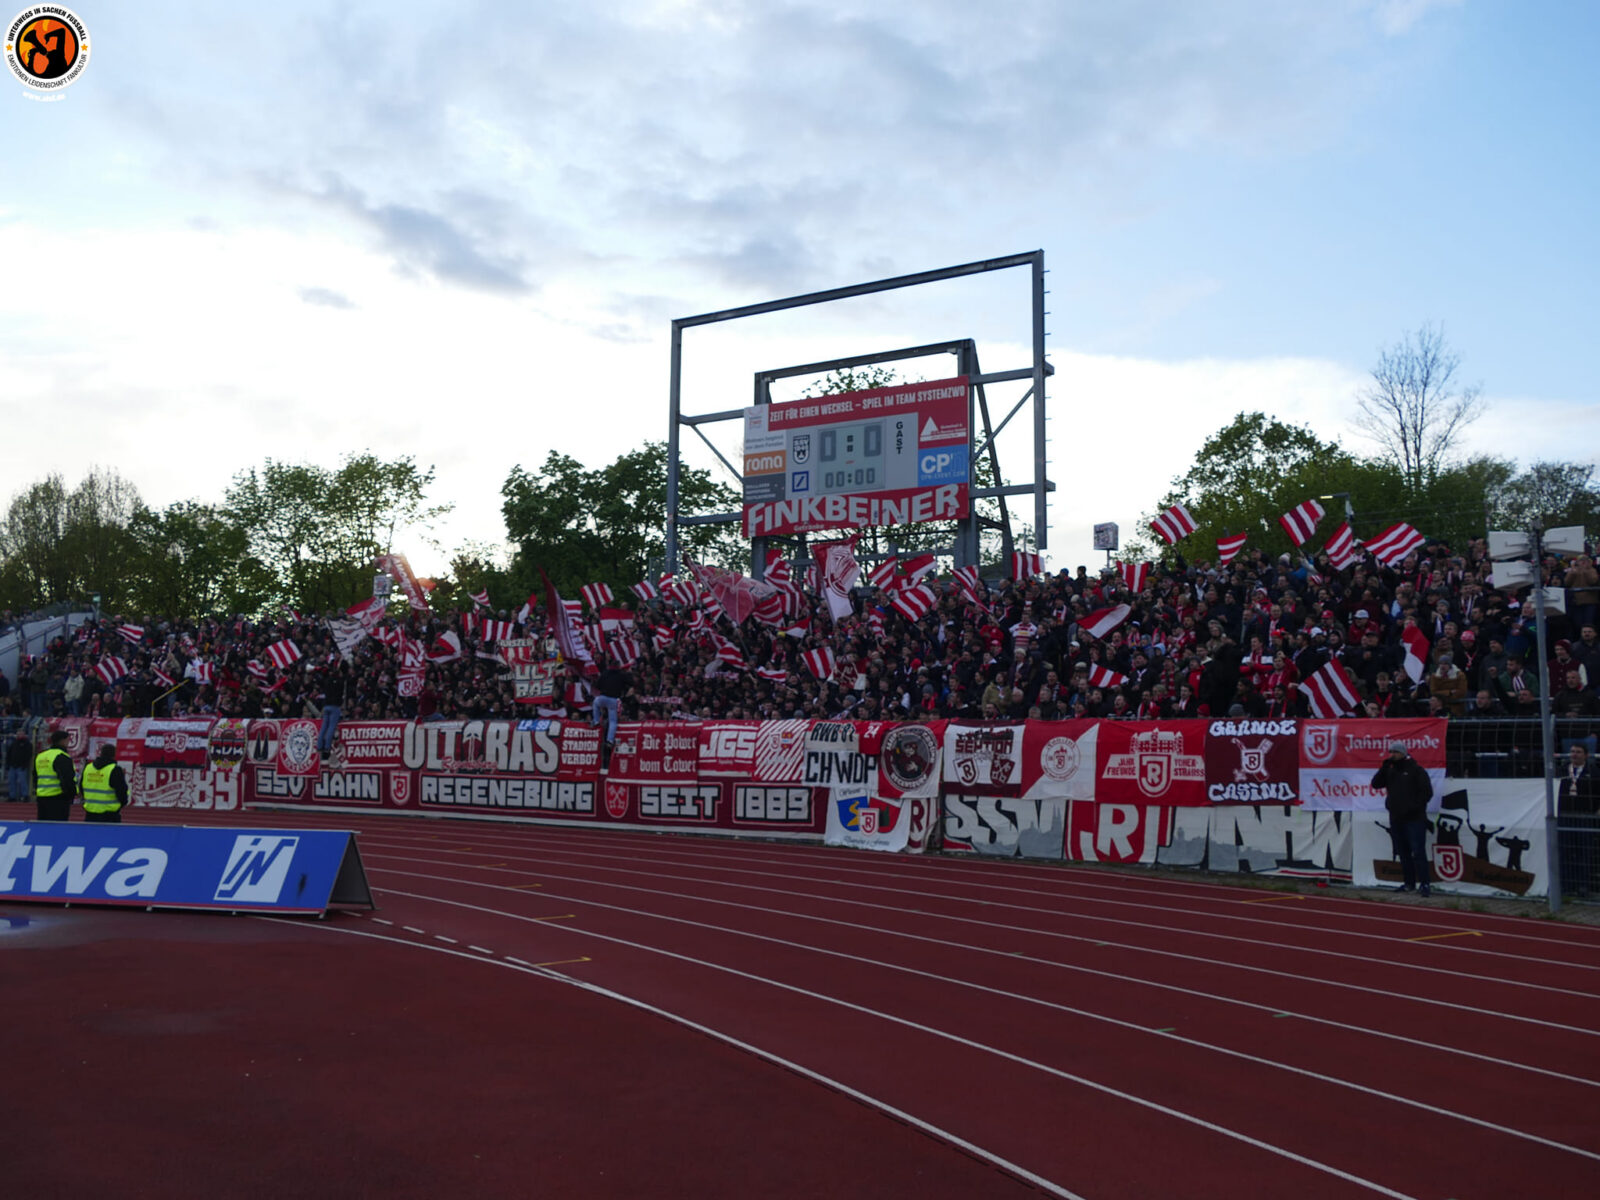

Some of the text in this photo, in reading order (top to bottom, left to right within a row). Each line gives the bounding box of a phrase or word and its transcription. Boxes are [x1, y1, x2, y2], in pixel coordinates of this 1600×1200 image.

[770, 409, 784, 422] ZEIT
[785, 406, 798, 420] FÜR
[800, 404, 820, 418] EINEN
[821, 402, 854, 416] WECHSEL
[862, 397, 883, 410] SPIEL
[884, 396, 894, 408] IM
[895, 392, 916, 405] TEAM
[917, 385, 965, 403] SYSTEMZWO
[895, 421, 904, 455] GAST
[745, 455, 783, 473] roma
[825, 467, 875, 489] 00:00
[748, 484, 960, 537] FINKBEINER
[341, 727, 401, 740] RATISBONA
[563, 727, 600, 739] SEKTION
[642, 733, 697, 753] Die Power
[347, 744, 401, 758] FANATICA
[562, 740, 599, 752] STADION
[700, 730, 757, 759] JGS
[561, 753, 598, 766] VERBOT
[639, 755, 697, 773] vom Tower
[805, 751, 877, 783] CHWDP
[256, 767, 811, 821] SSV JAHN REGENSBURG SEIT 1889
